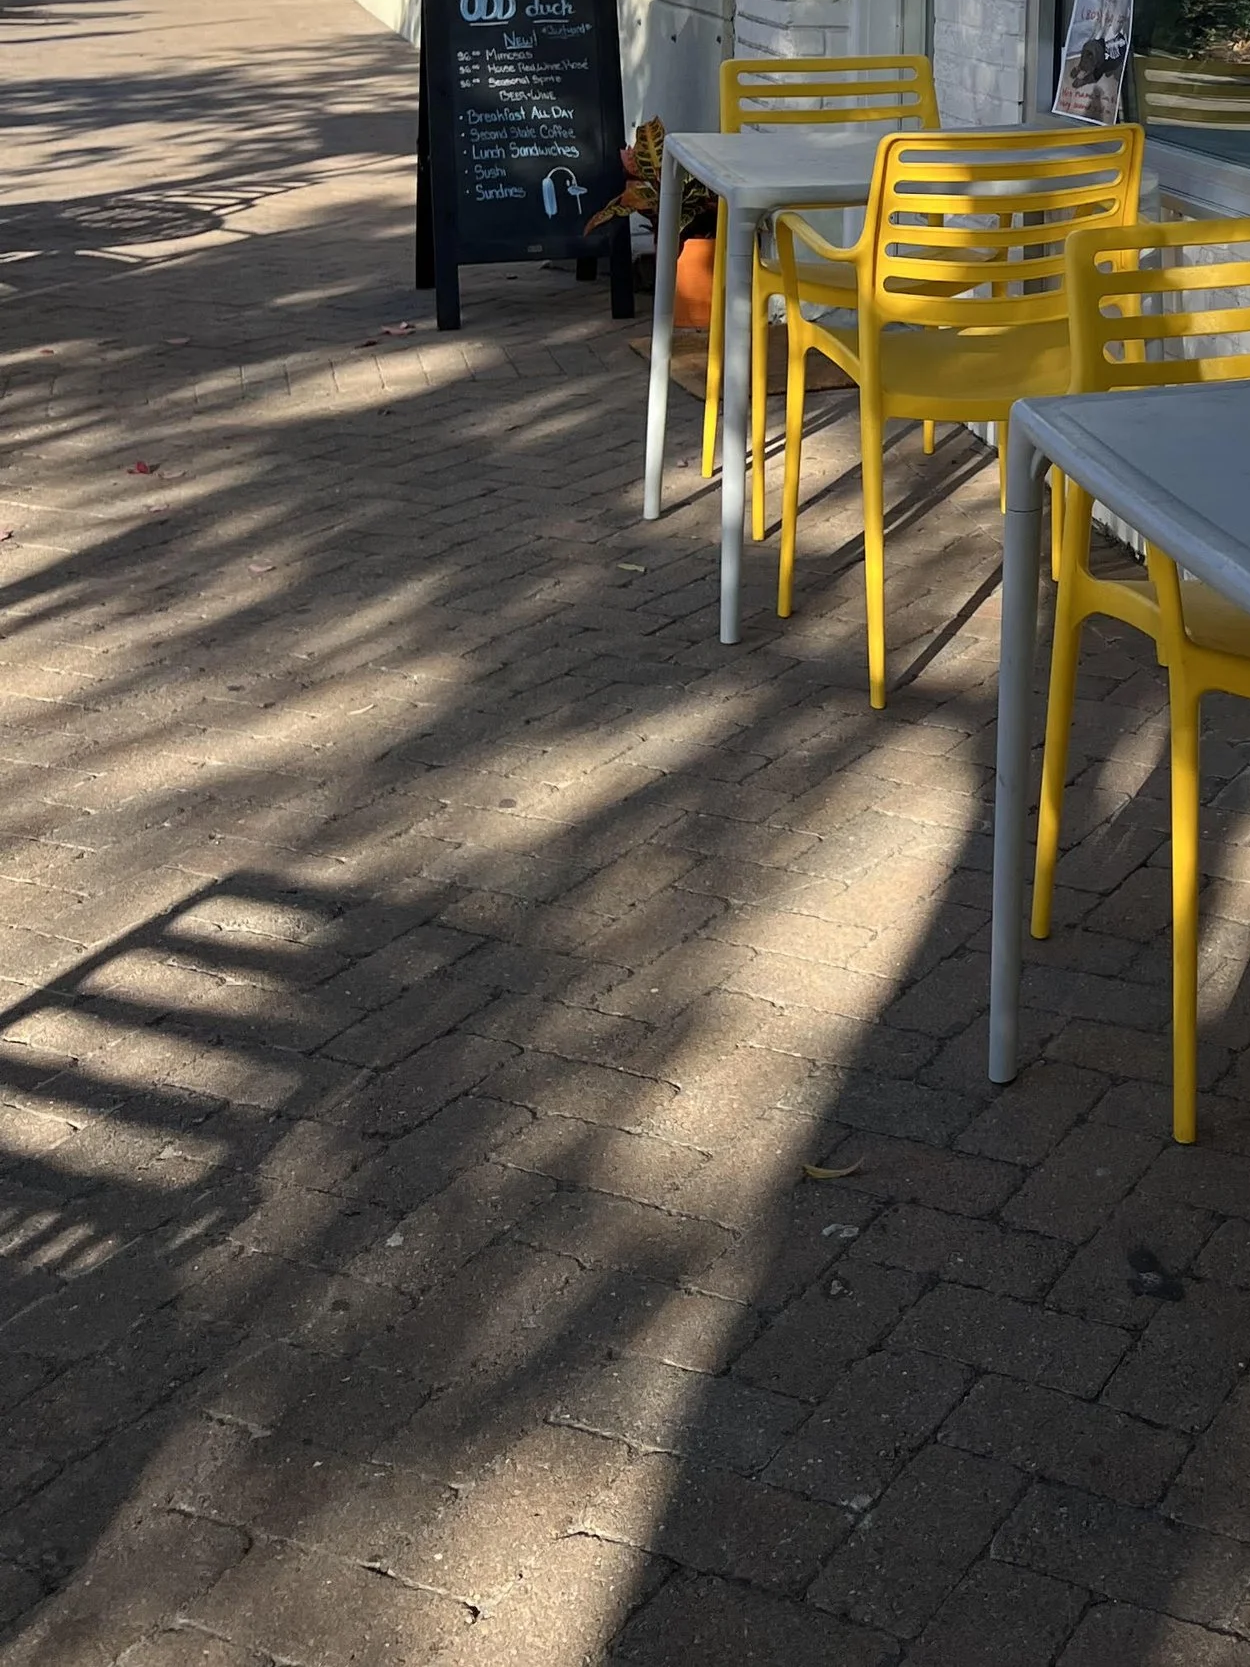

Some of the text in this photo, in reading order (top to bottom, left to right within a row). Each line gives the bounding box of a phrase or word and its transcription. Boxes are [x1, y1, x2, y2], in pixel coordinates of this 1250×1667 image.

[485, 47, 534, 61] Mimosas
[487, 63, 516, 74] House
[488, 75, 530, 88] Seasonal
[466, 105, 575, 125] Breakfast ALL DAY
[470, 123, 576, 143] Second State Coffee
[472, 141, 580, 160] Lunch Sandwiches
[474, 163, 507, 181] Sushi
